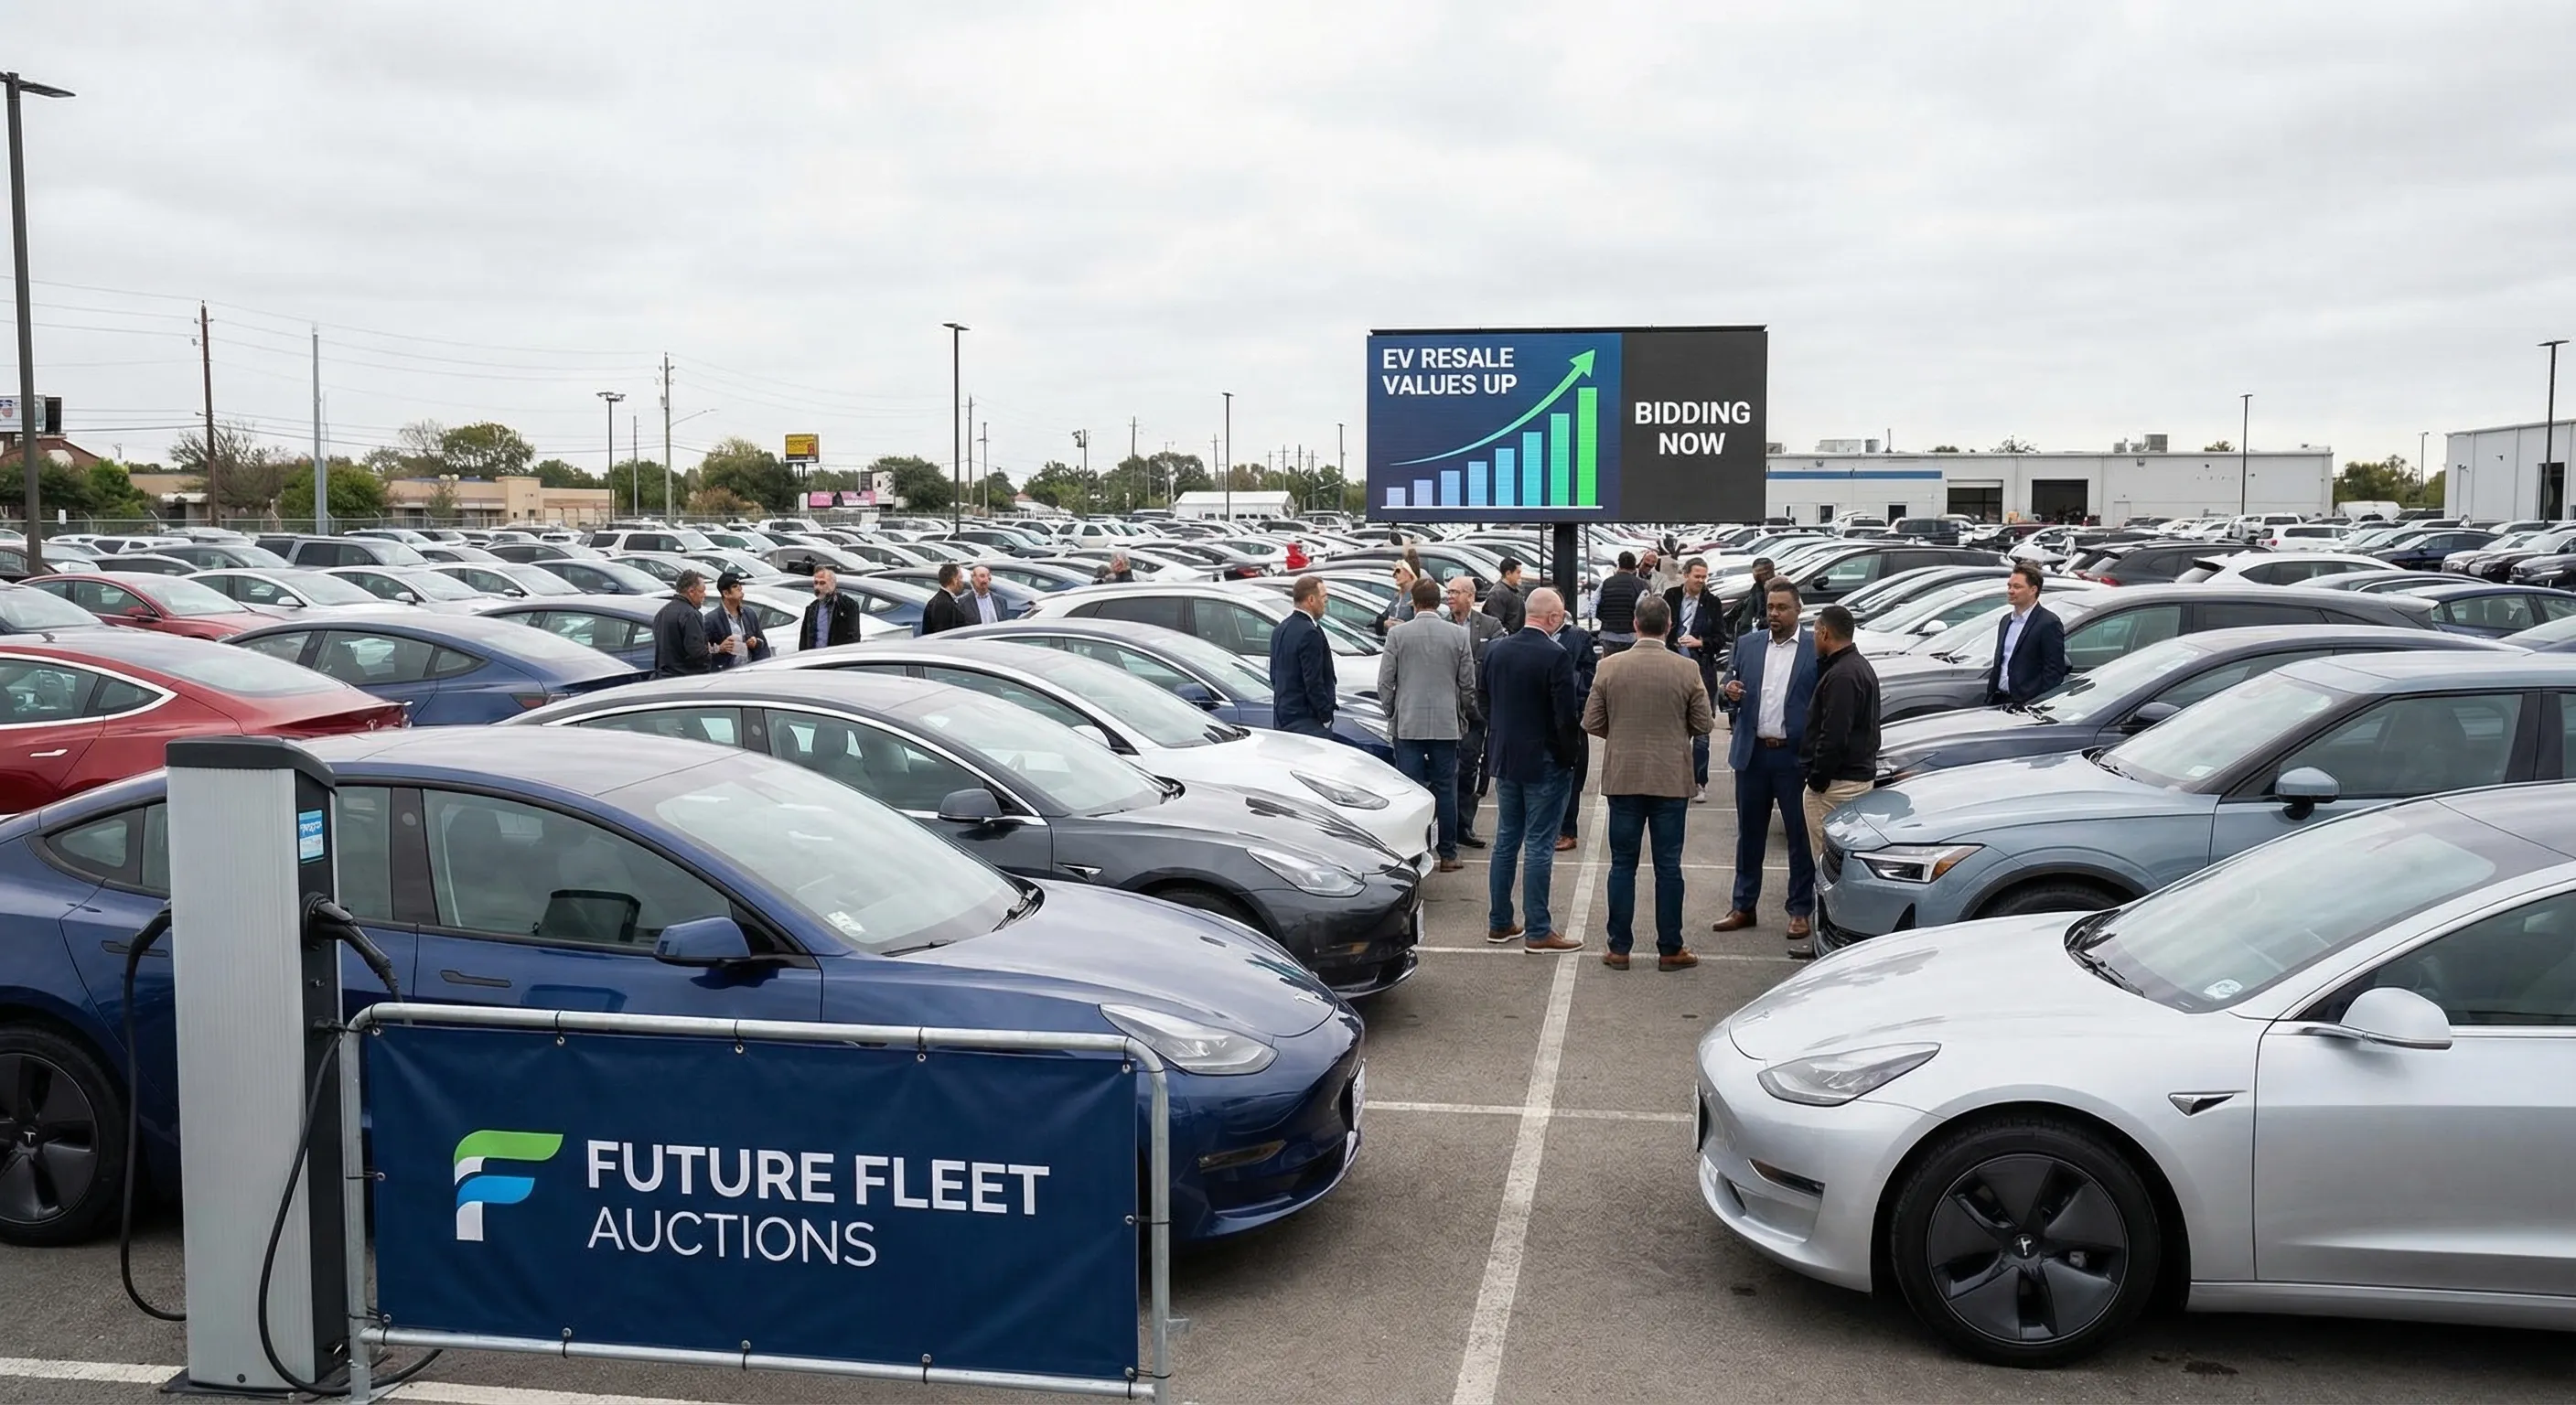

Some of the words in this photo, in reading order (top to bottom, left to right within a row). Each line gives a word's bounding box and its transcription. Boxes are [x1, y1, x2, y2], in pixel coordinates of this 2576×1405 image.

[1382, 348, 1415, 370] EV
[1421, 347, 1515, 369] RESALE
[1382, 374, 1477, 395] VALUES
[1484, 373, 1518, 394] UP
[1635, 401, 1751, 424] BIDDING
[1658, 432, 1726, 456] NOW
[587, 1139, 835, 1204] FUTURE
[855, 1153, 1050, 1216] FLEET
[587, 1206, 876, 1267] AUCTIONS
